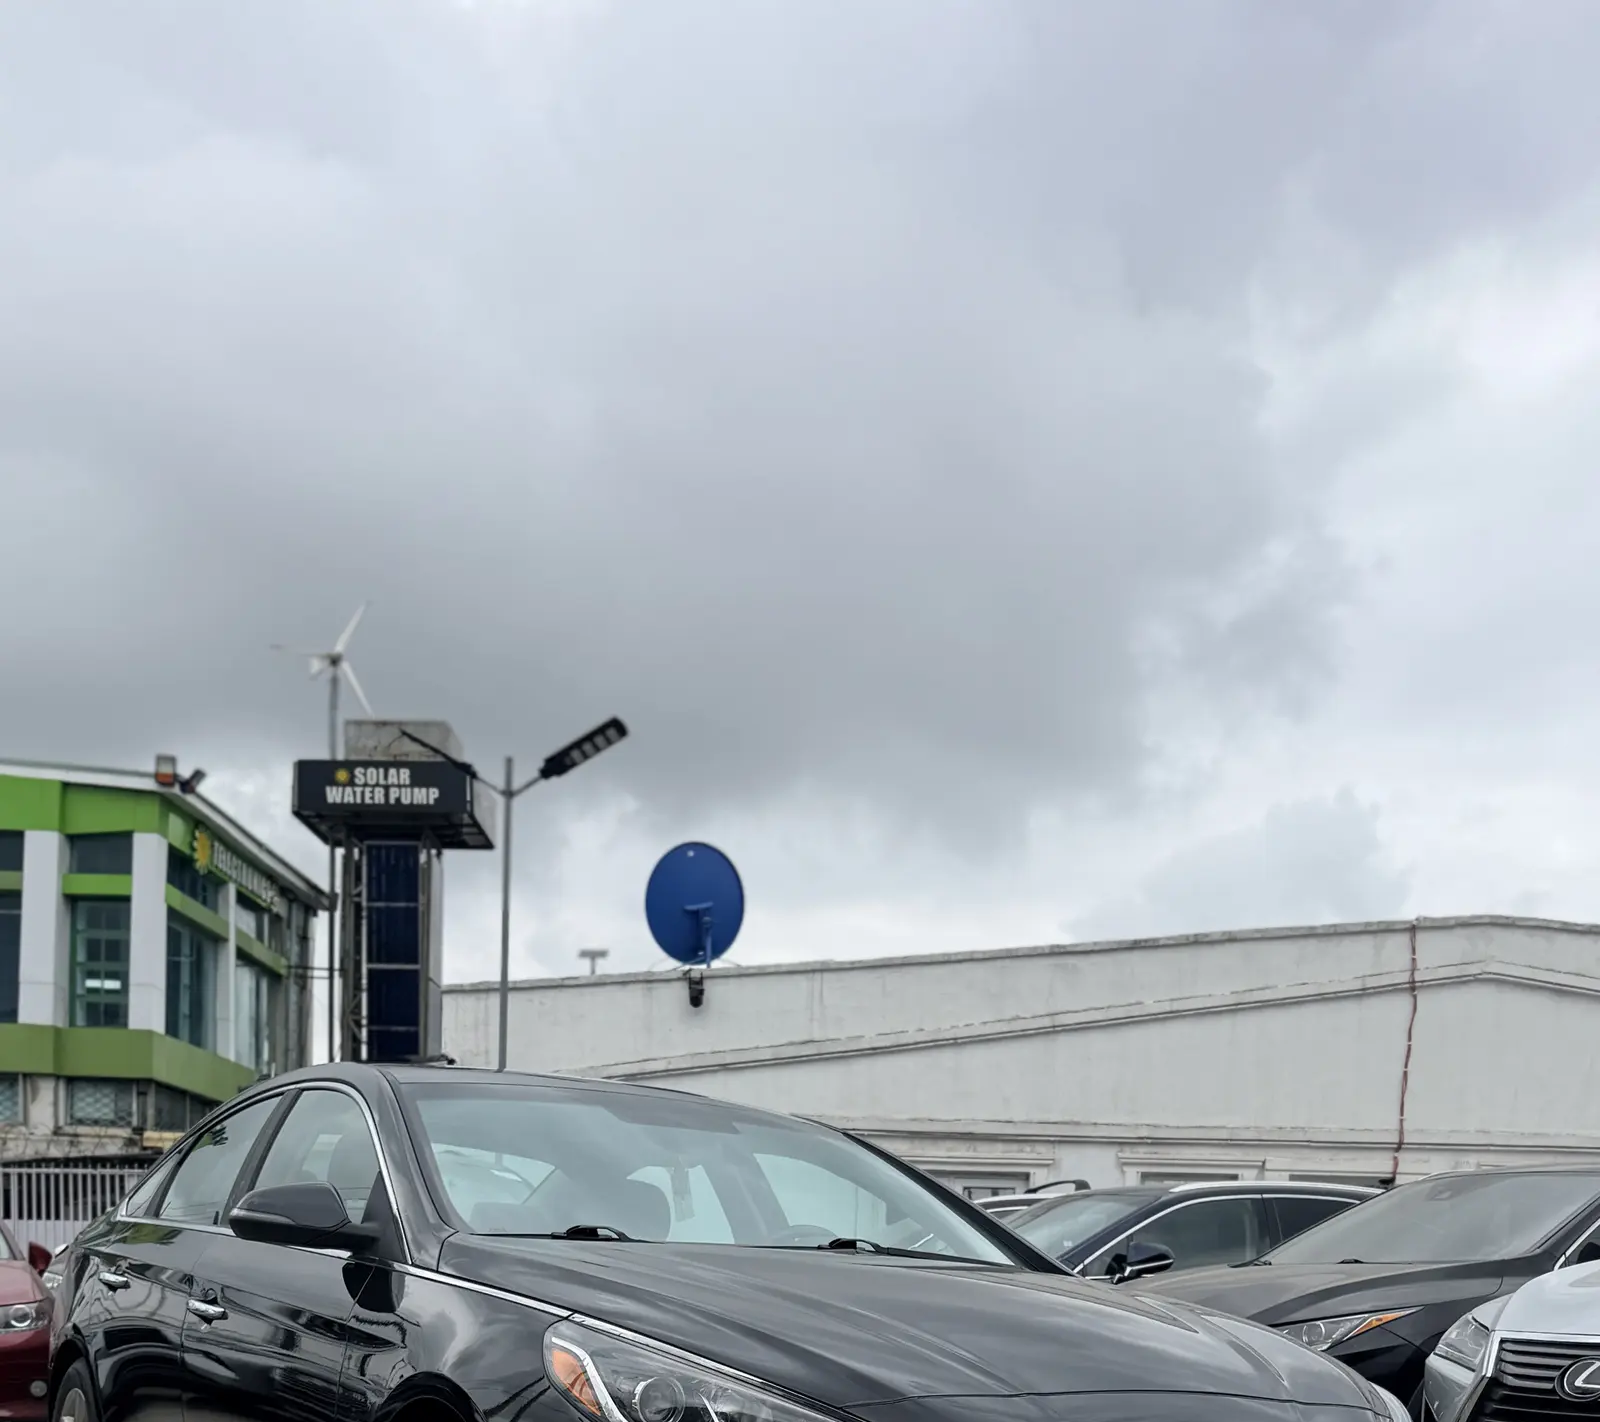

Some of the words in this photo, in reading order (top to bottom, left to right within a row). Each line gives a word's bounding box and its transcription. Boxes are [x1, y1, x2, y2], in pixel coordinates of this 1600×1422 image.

[353, 767, 411, 786] SOLAR
[325, 786, 386, 804] WATER
[389, 787, 440, 805] PUMP
